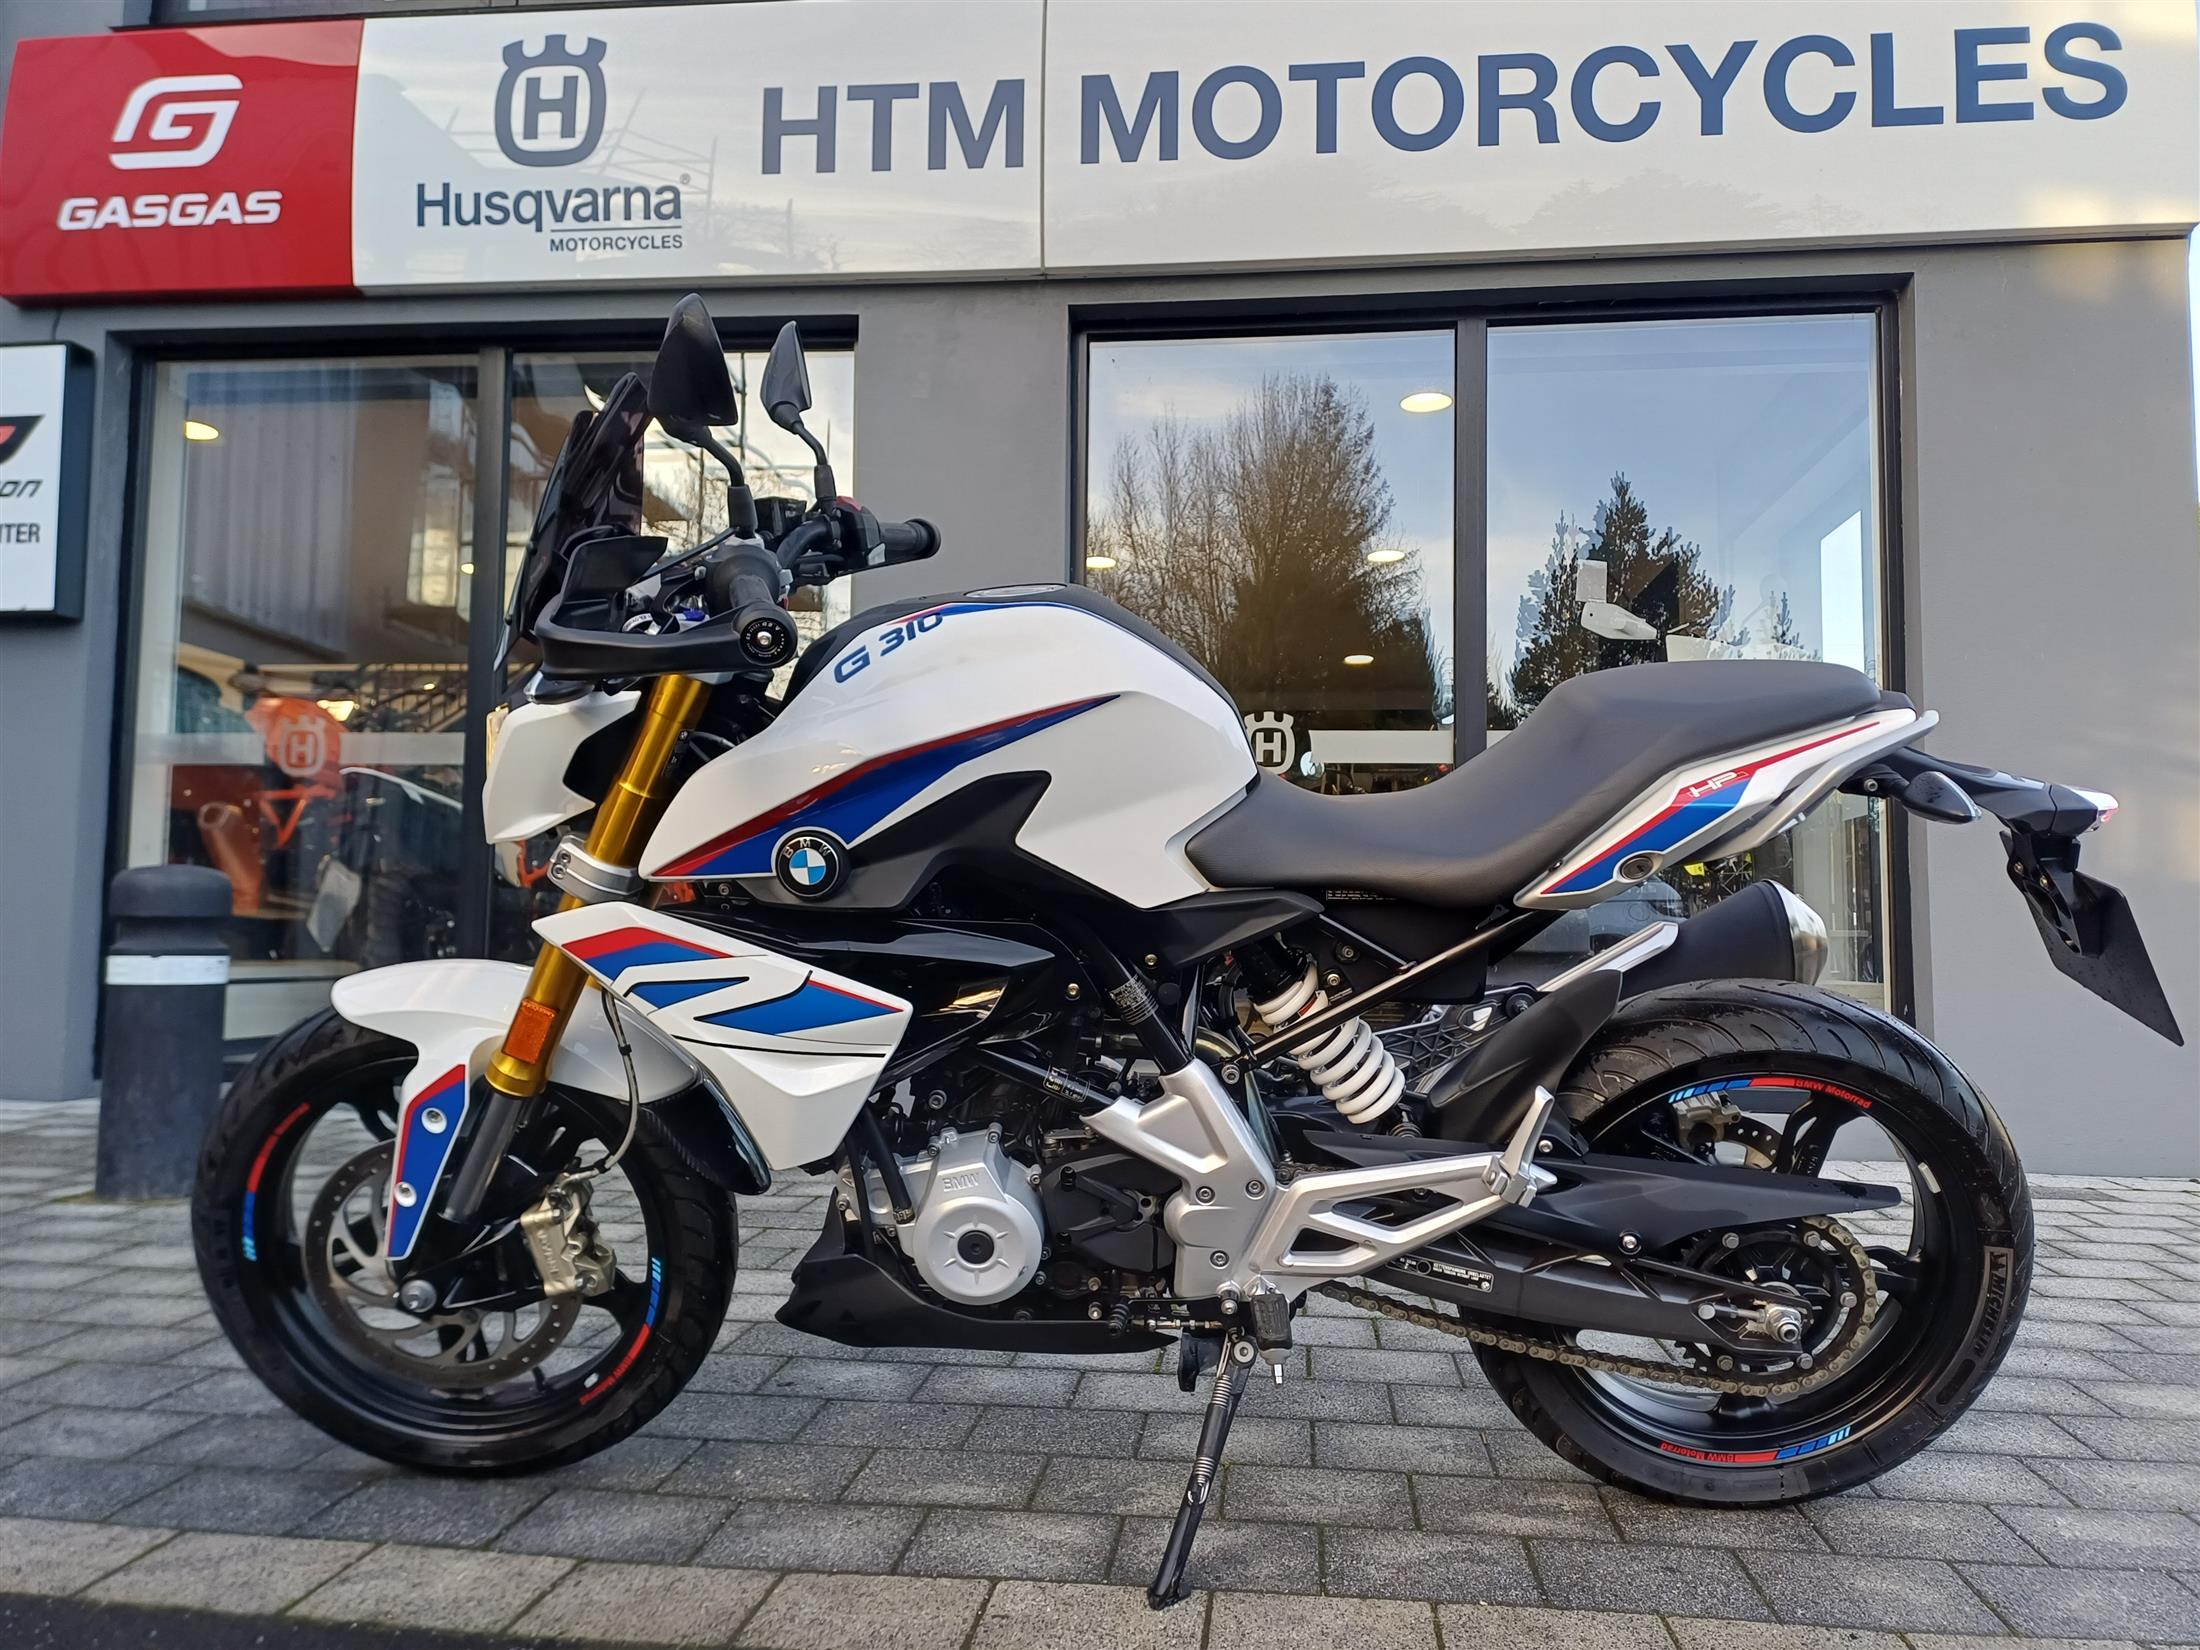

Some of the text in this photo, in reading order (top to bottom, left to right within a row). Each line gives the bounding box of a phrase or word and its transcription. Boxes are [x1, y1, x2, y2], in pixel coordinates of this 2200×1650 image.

[761, 22, 2129, 174] HTM MOTORCYCLES
[57, 190, 283, 231] GASGAS
[416, 182, 683, 233] Husqvarna
[549, 235, 683, 252] MOTORCYCLES
[0, 523, 41, 544] TER
[834, 612, 943, 684] G 310
[1687, 771, 1738, 798] HP
[783, 837, 832, 858] BMW
[1796, 1079, 1872, 1109] BMW Motorrad
[943, 1173, 979, 1192] BMW
[1660, 1442, 1735, 1463] BMW Motorrad
